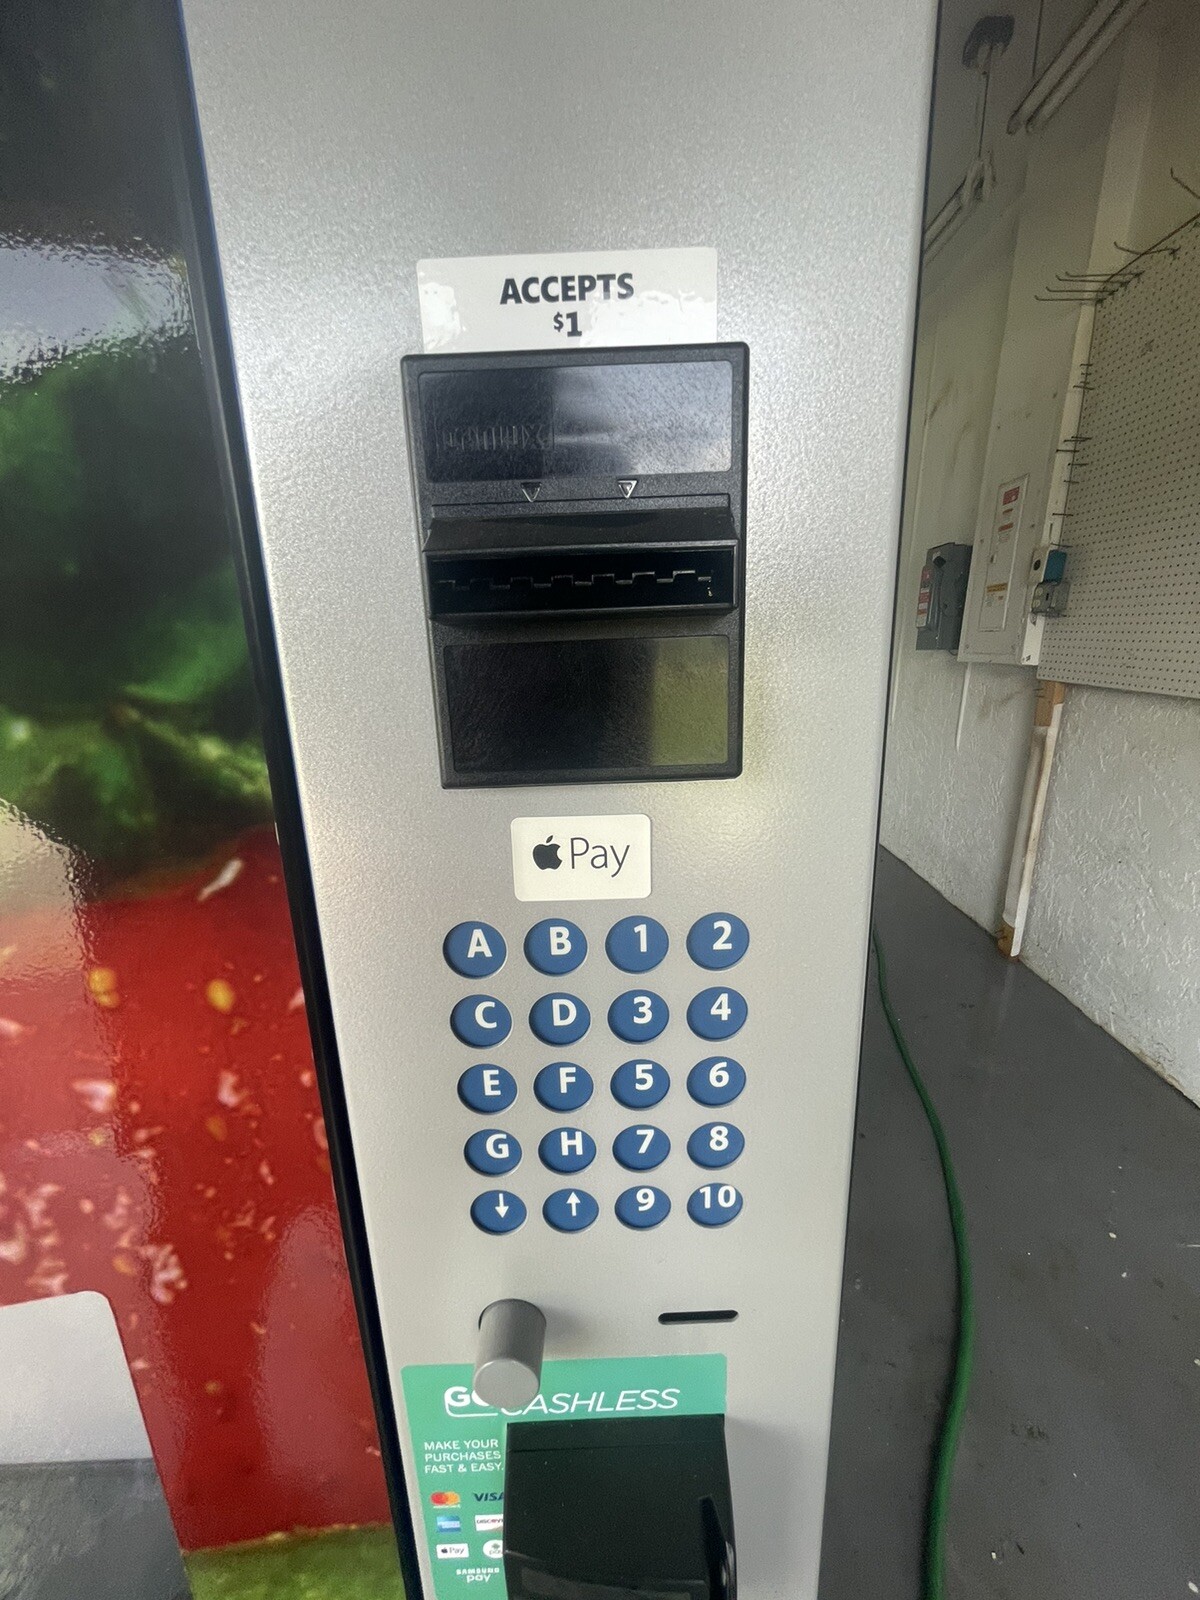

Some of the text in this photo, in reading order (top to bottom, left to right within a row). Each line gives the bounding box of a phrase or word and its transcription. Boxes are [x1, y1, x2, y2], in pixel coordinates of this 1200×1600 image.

[499, 272, 634, 305] ACCEPTS
[553, 311, 582, 338] $1
[570, 837, 630, 877] Pay
[467, 929, 492, 958] A
[549, 926, 572, 955] B
[633, 924, 648, 952] 1
[712, 920, 732, 950] 2
[474, 1001, 497, 1029] C
[552, 999, 577, 1026] D
[633, 996, 653, 1024] 3
[710, 993, 731, 1021] 4
[482, 1069, 501, 1096] E
[559, 1067, 576, 1093] F
[635, 1064, 654, 1090] 5
[709, 1061, 730, 1088] 6
[486, 1133, 509, 1159] G
[560, 1131, 584, 1156] H
[636, 1129, 655, 1154] 7
[709, 1125, 729, 1151] 8
[635, 1188, 655, 1212] 9
[699, 1185, 736, 1209] 10
[444, 1386, 681, 1416] G ASHLESS
[424, 1439, 499, 1451] MAKE YOUR
[424, 1450, 502, 1462] PURCHASES
[424, 1462, 504, 1474] FAST & EASY.
[455, 1567, 500, 1576] SAMSUNG
[466, 1574, 491, 1584] pay
